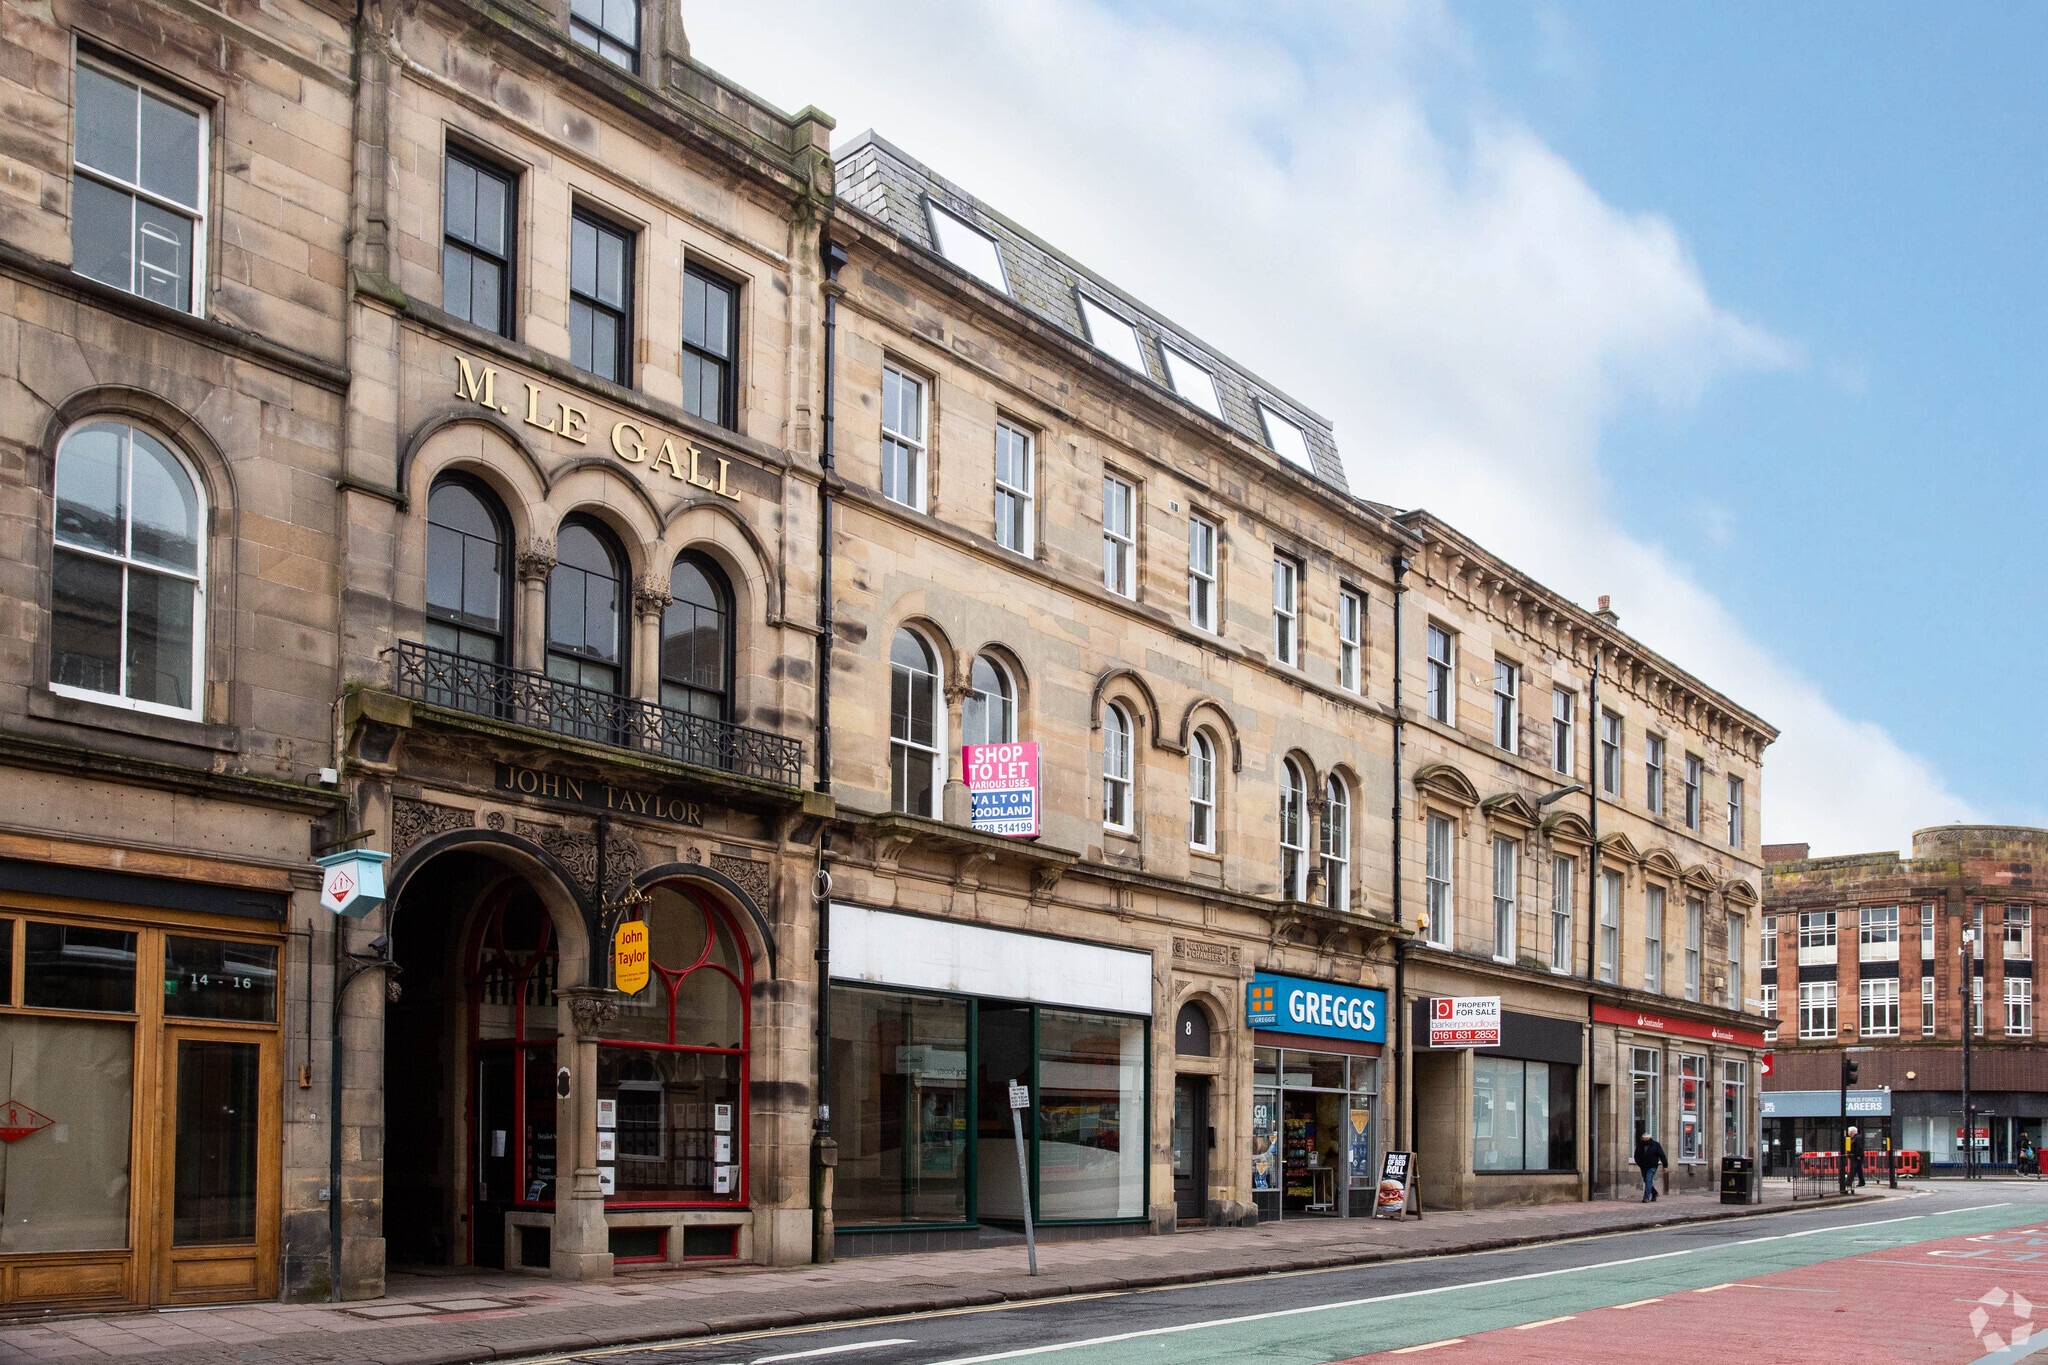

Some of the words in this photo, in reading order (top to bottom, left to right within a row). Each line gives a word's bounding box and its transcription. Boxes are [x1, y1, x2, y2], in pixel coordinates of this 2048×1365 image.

[455, 355, 508, 415] M.
[523, 383, 588, 445] LE
[611, 421, 742, 502] GALL
[974, 745, 1023, 764] SHOP
[968, 763, 993, 780] TO
[998, 762, 1029, 779] LET
[969, 780, 1007, 790] VARIOUS
[1008, 778, 1030, 788] USES
[505, 766, 584, 801] JOHN
[601, 784, 701, 826] TAYLOR
[997, 822, 1033, 833] 514199
[621, 929, 643, 945] John
[617, 949, 647, 967] Taylor
[190, 973, 209, 986] 14
[233, 976, 252, 989] 16
[1288, 989, 1376, 1032] GREGGS
[1475, 1008, 1497, 1016] SALE
[1185, 1021, 1192, 1036] 8
[1643, 1016, 1664, 1029] Santander
[1433, 1031, 1453, 1040] 0161
[1455, 1030, 1473, 1039] 631
[1474, 1030, 1497, 1039] 2852
[1716, 1030, 1734, 1041] Santander
[1254, 1104, 1267, 1118] GO
[1846, 1102, 1883, 1111] AREERS
[1386, 1165, 1404, 1175] ROLL
